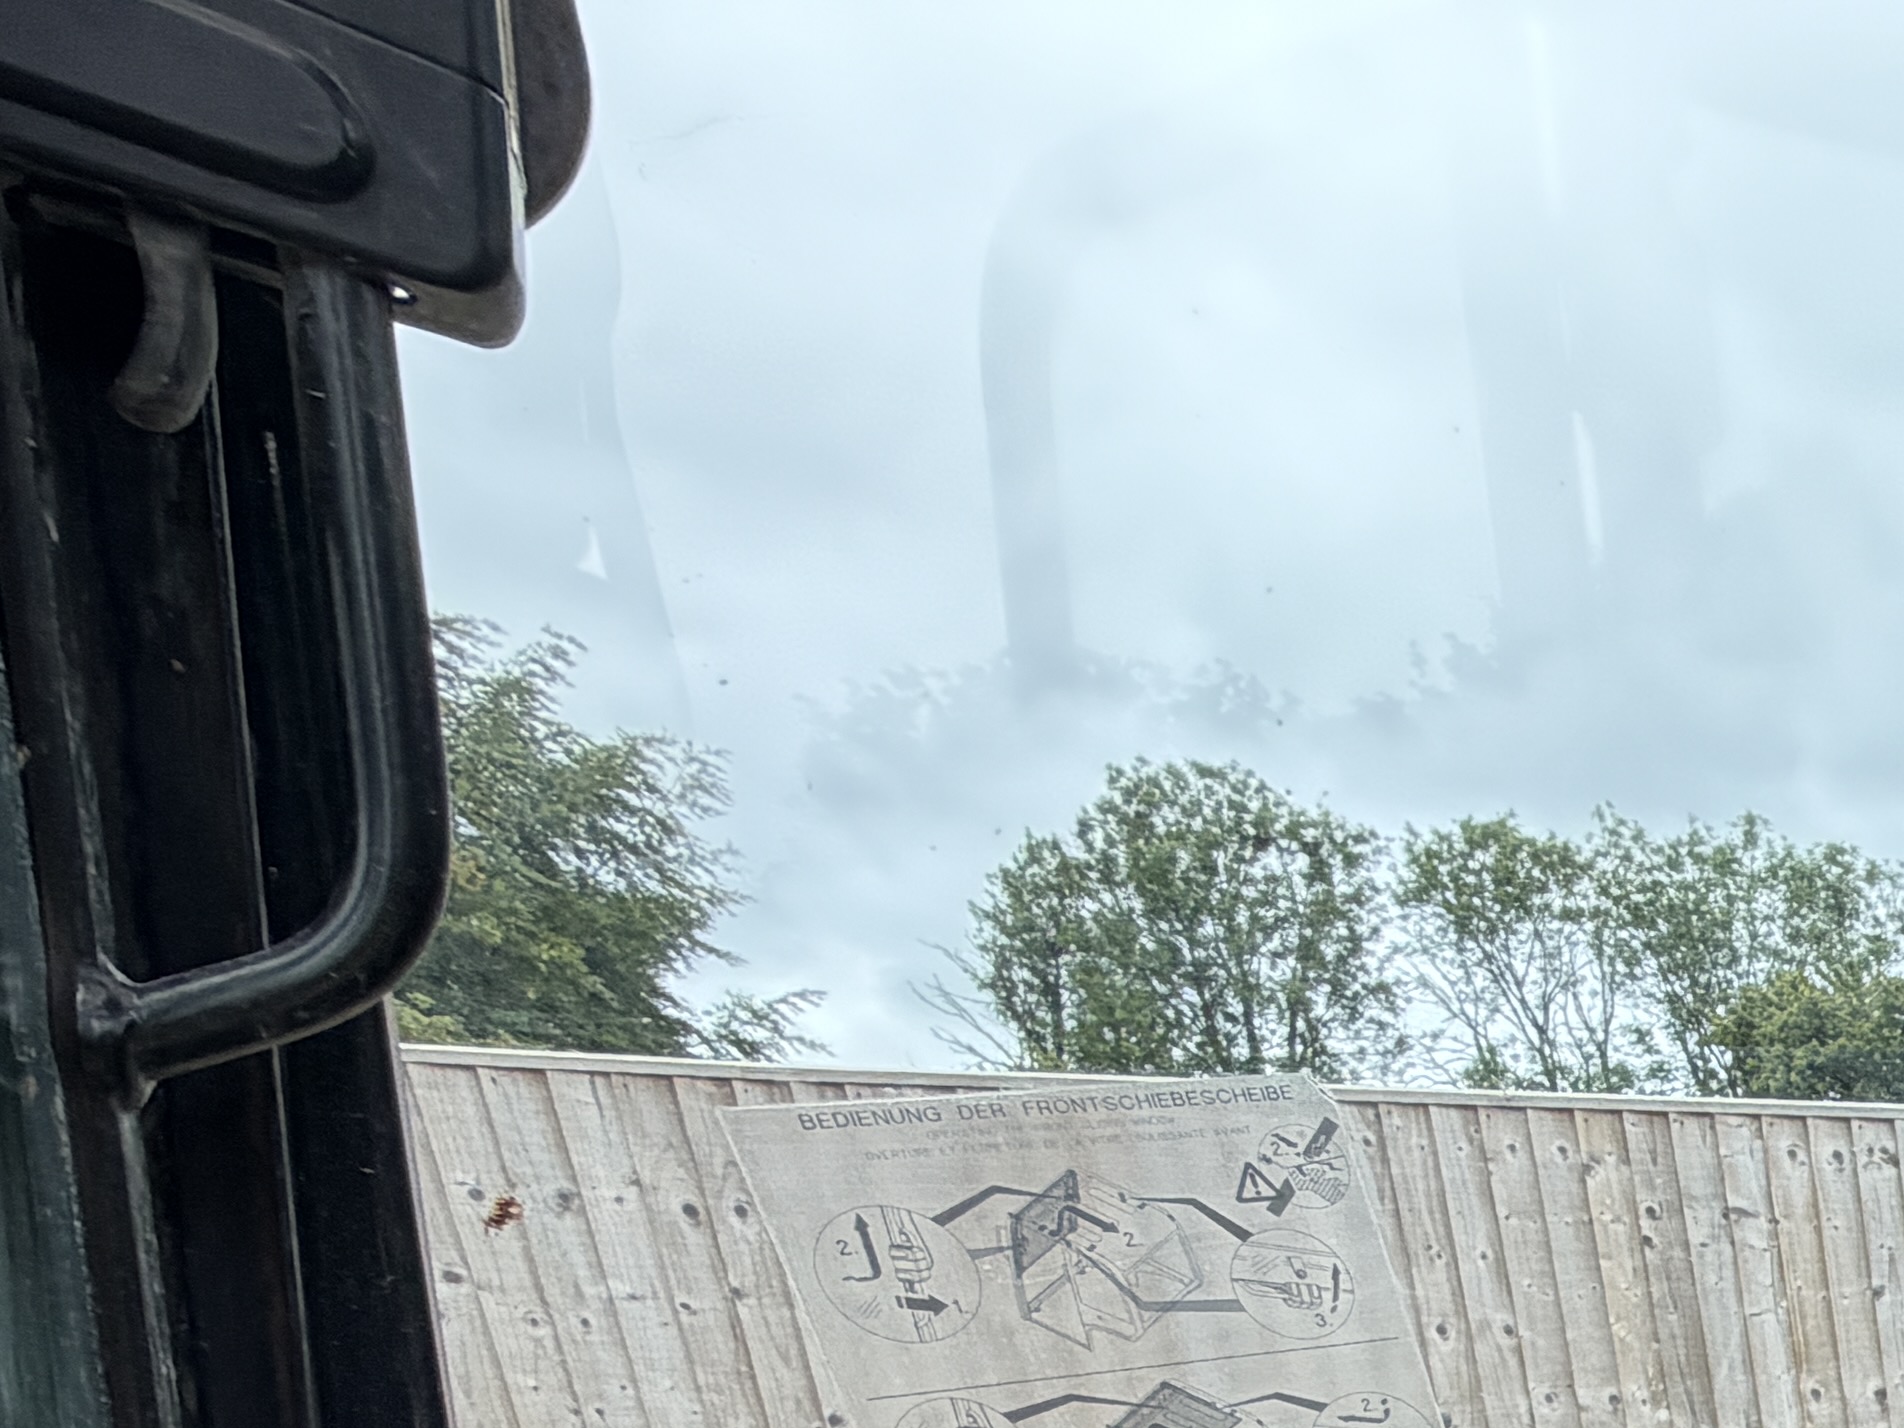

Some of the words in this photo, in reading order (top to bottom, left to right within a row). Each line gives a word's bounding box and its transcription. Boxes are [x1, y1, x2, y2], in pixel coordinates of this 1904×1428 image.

[798, 1106, 943, 1131] BEDIENUNG
[957, 1103, 1007, 1121] DER
[1023, 1084, 1294, 1117] FRONTSCHIEBESCHEIBE
